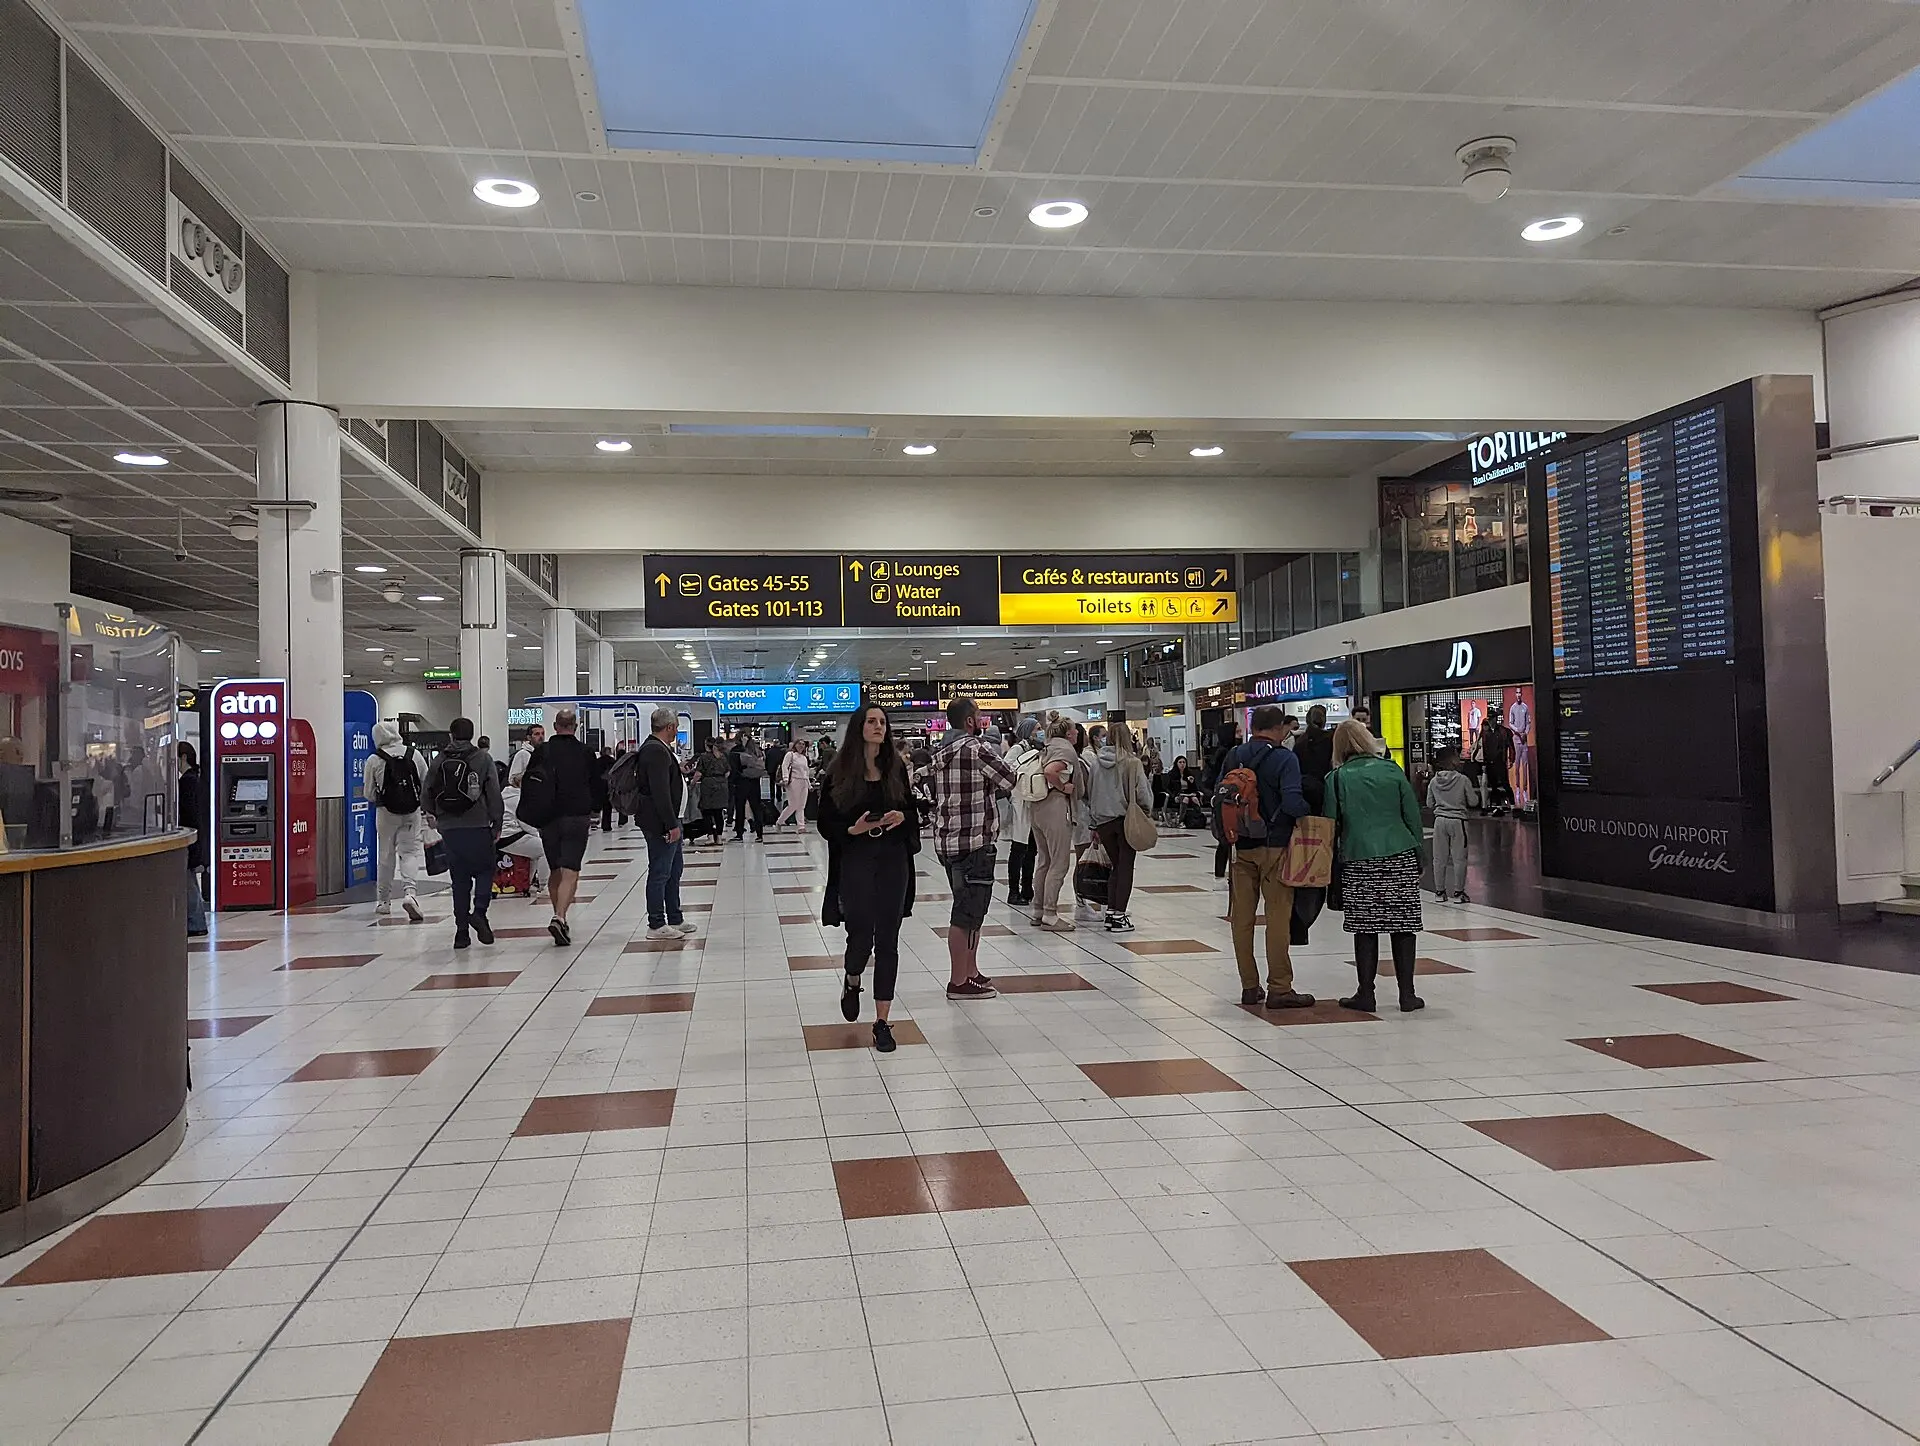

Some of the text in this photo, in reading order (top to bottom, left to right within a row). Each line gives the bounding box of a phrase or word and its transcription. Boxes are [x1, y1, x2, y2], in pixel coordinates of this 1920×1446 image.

[1472, 474, 1486, 486] Real
[1486, 465, 1514, 481] California
[894, 562, 960, 579] Lounges
[1022, 568, 1179, 585] Cafés & restaurants
[707, 575, 809, 591] Gates 45-55
[895, 584, 941, 599] Water
[708, 601, 823, 617] Gates 101-113
[895, 602, 961, 617] fountain
[1077, 599, 1132, 613] Toilets
[1446, 641, 1473, 679] JD
[624, 685, 672, 695] currency
[1255, 672, 1308, 699] COLLECTION
[220, 691, 277, 714] atm
[727, 689, 766, 700] protect
[728, 701, 757, 711] other
[353, 731, 368, 750] atm
[293, 819, 308, 833] atm
[1562, 816, 1729, 846] YOUR LONDON AIRPORT
[1648, 844, 1735, 873] Gatwick
